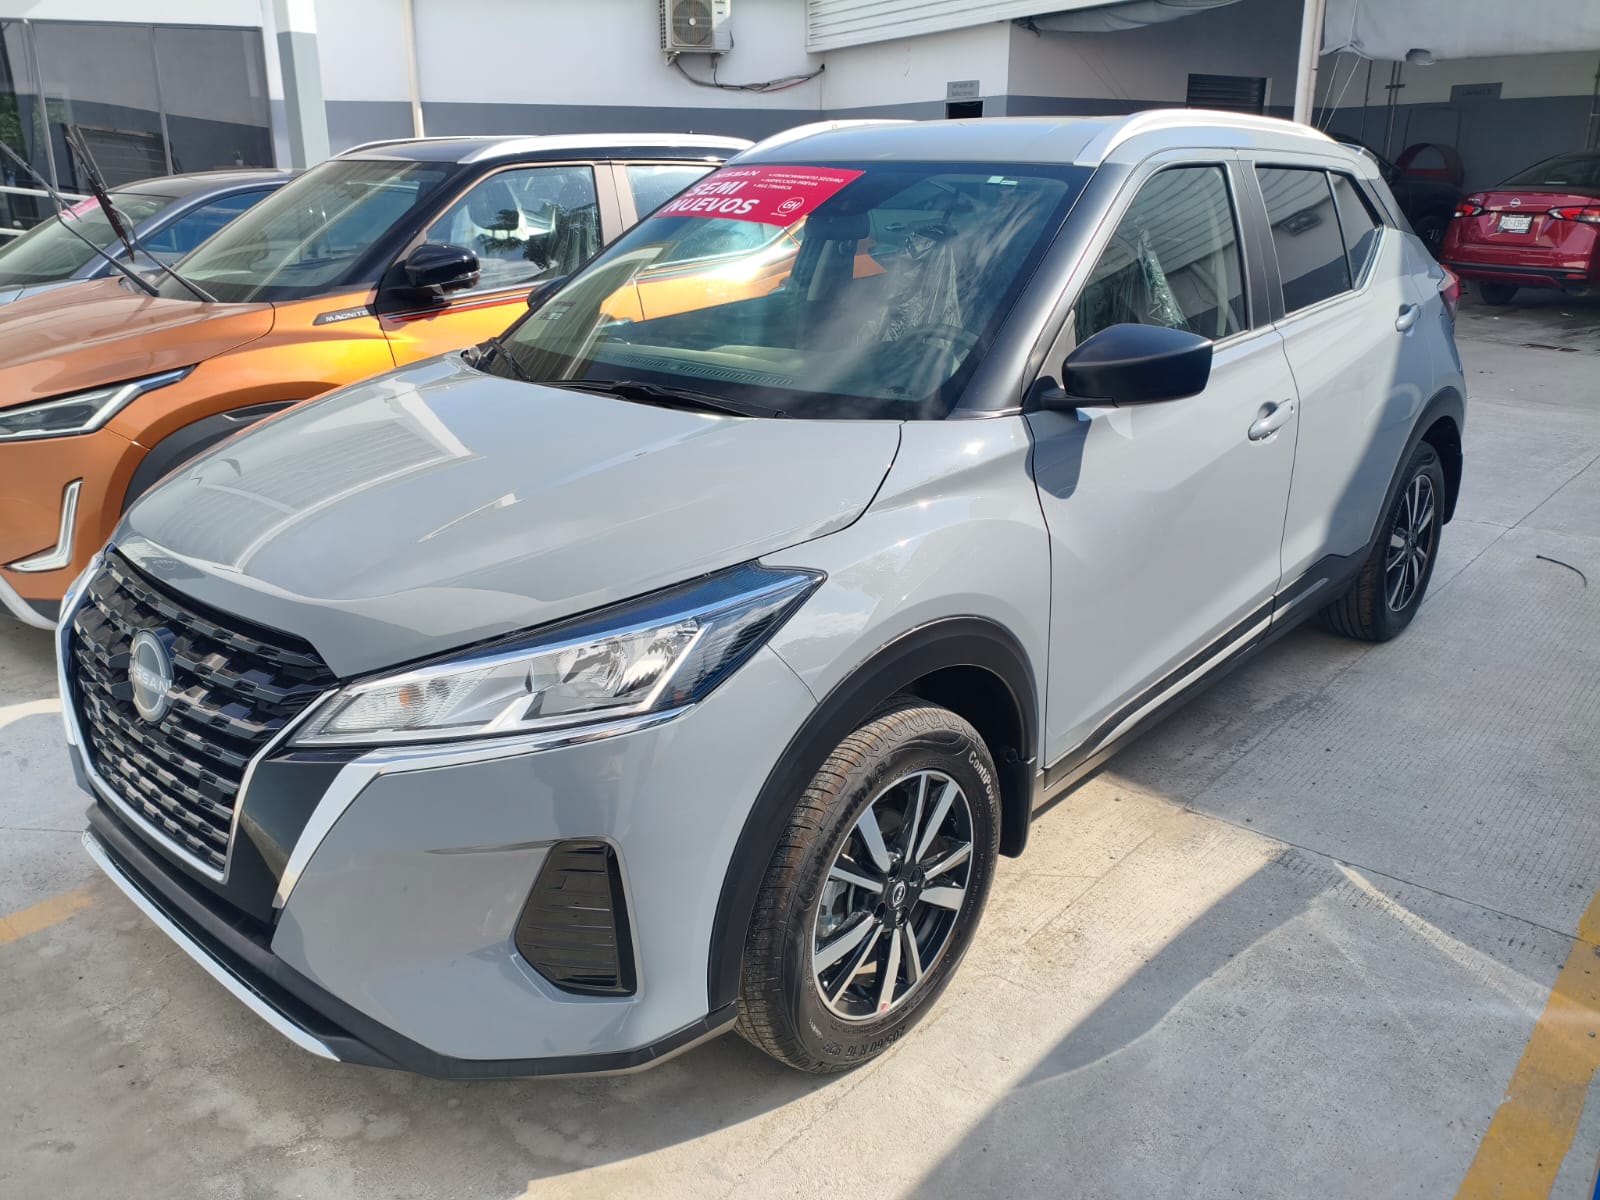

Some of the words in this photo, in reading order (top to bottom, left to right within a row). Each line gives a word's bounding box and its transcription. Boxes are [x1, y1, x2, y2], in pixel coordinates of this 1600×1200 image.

[685, 181, 749, 198] SEMI
[663, 197, 761, 215] NUEVOS
[782, 200, 801, 211] GH
[130, 664, 168, 692] SSAN
